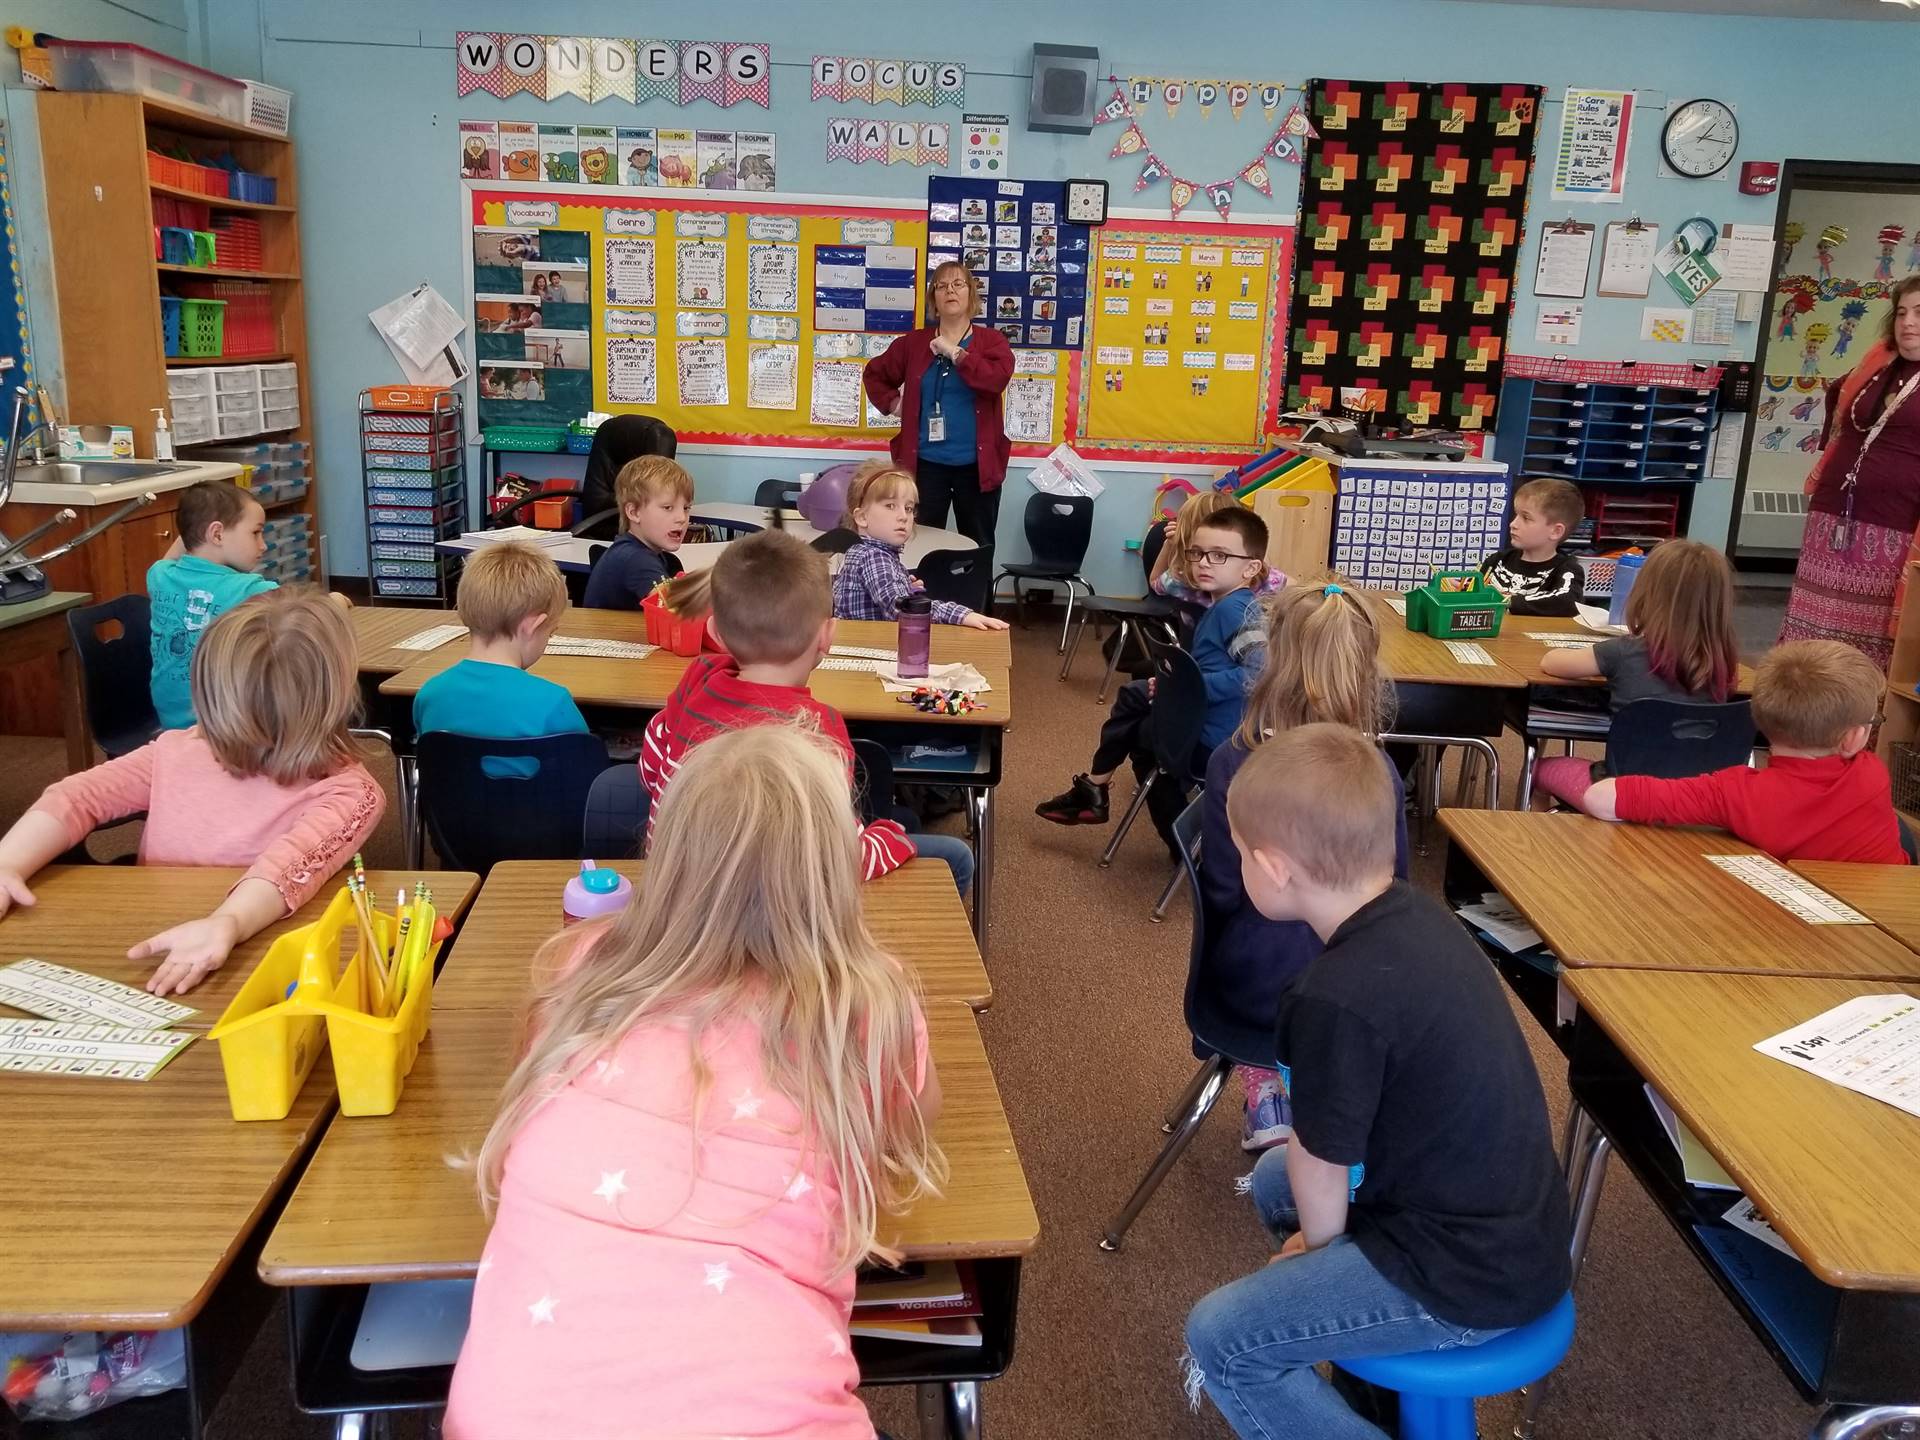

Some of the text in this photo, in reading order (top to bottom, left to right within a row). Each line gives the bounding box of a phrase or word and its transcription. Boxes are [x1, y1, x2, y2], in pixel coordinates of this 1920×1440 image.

[466, 44, 758, 79] WONDERS
[821, 63, 957, 87] FOCUS
[1134, 83, 1281, 109] Happy
[1576, 104, 1600, 112] Rules
[1701, 103, 1711, 112] 12
[1725, 121, 1731, 129] 2
[832, 124, 940, 148] WALL
[1727, 135, 1733, 144] 3
[1671, 148, 1677, 156] 8
[1721, 151, 1727, 159] 4
[1694, 165, 1700, 173] 6
[1709, 162, 1715, 170] 5
[1000, 183, 1014, 192] Day
[511, 209, 552, 218] Vocabulary
[617, 217, 646, 227] Genre
[1240, 254, 1255, 263] April
[1680, 259, 1708, 292] YES
[1197, 303, 1209, 312] July
[611, 317, 651, 326] Mechanics
[683, 320, 721, 328] Grammar
[1017, 384, 1034, 392] What
[1459, 615, 1482, 627] TABLE
[28, 979, 103, 1009] Serenity
[3, 1034, 98, 1056] Mariana
[1794, 1035, 1831, 1051] I Spy
[899, 1299, 973, 1310] Workshop
